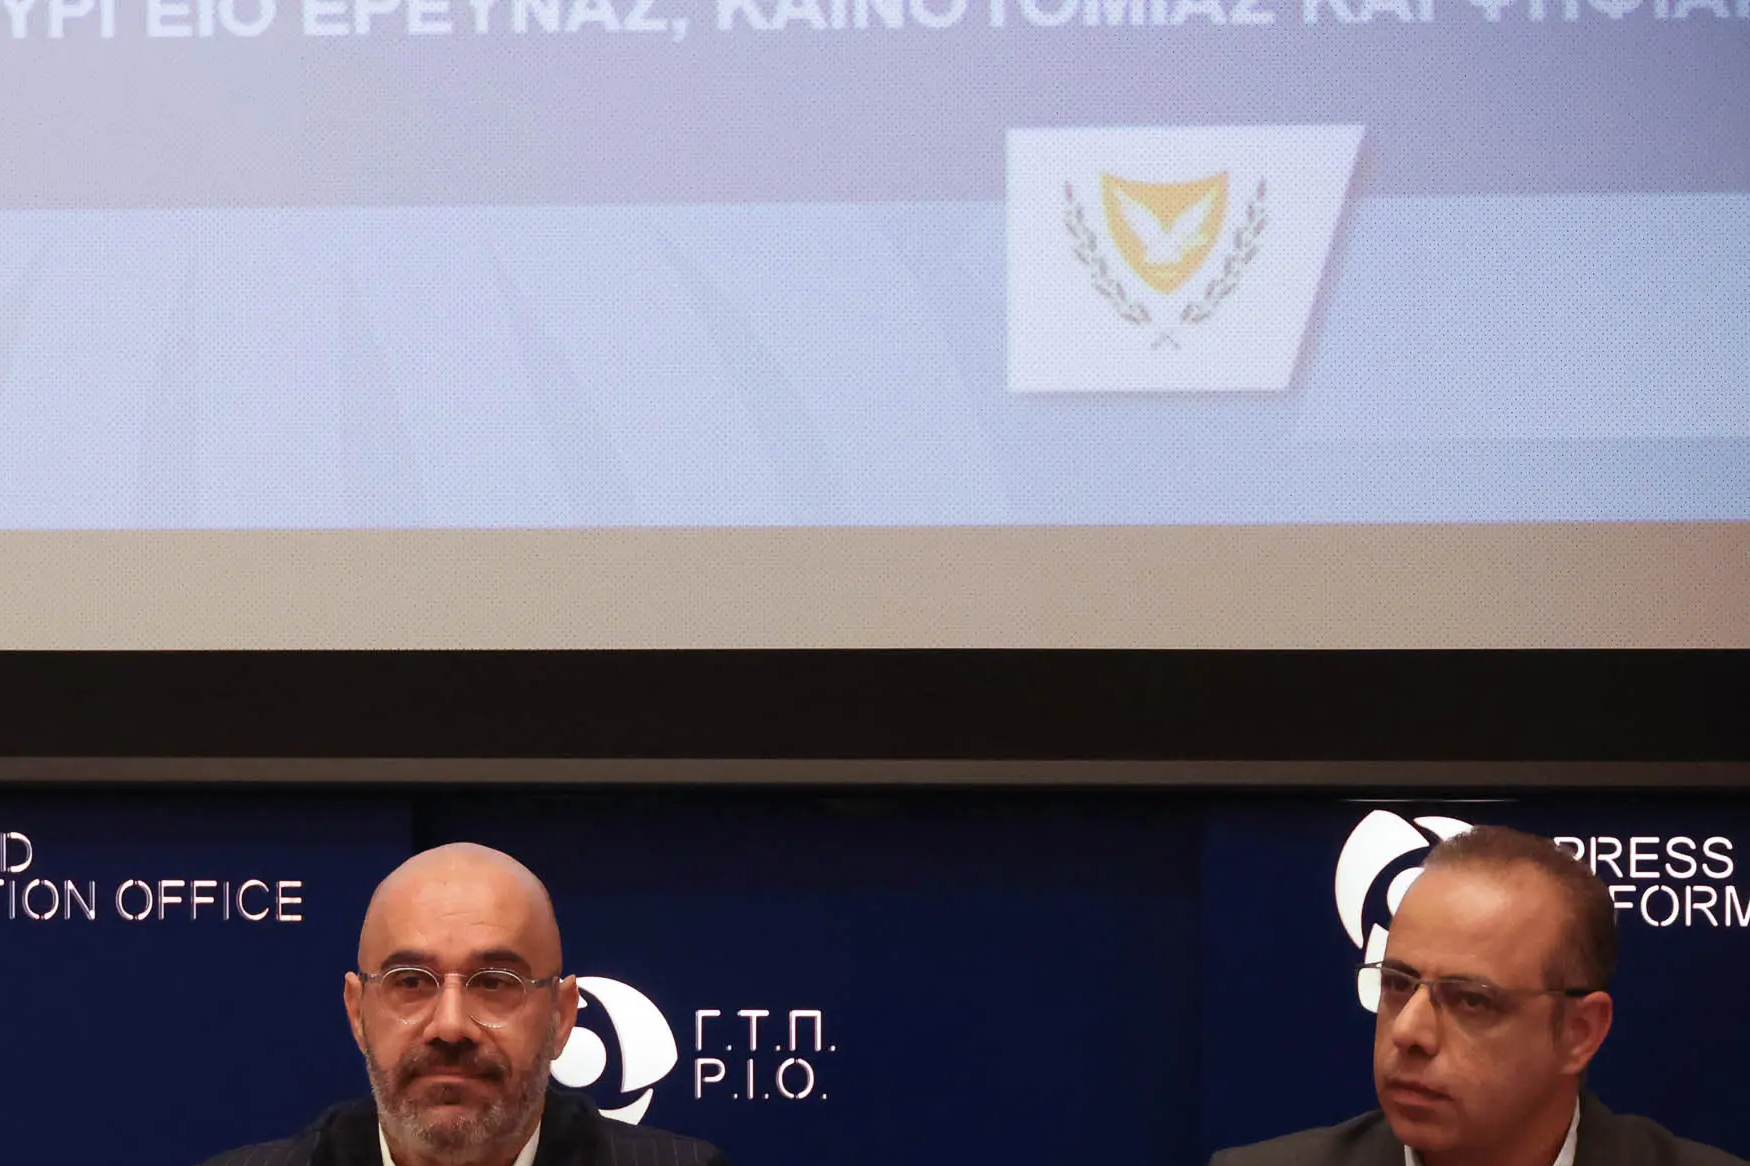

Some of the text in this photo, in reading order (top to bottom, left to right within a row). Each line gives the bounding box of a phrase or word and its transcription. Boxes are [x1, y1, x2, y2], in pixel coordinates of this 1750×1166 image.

[116, 879, 303, 922] OFFICE
[695, 1009, 837, 1052] Γ.Τ.Π.
[694, 1057, 828, 1100] P.I.O.
